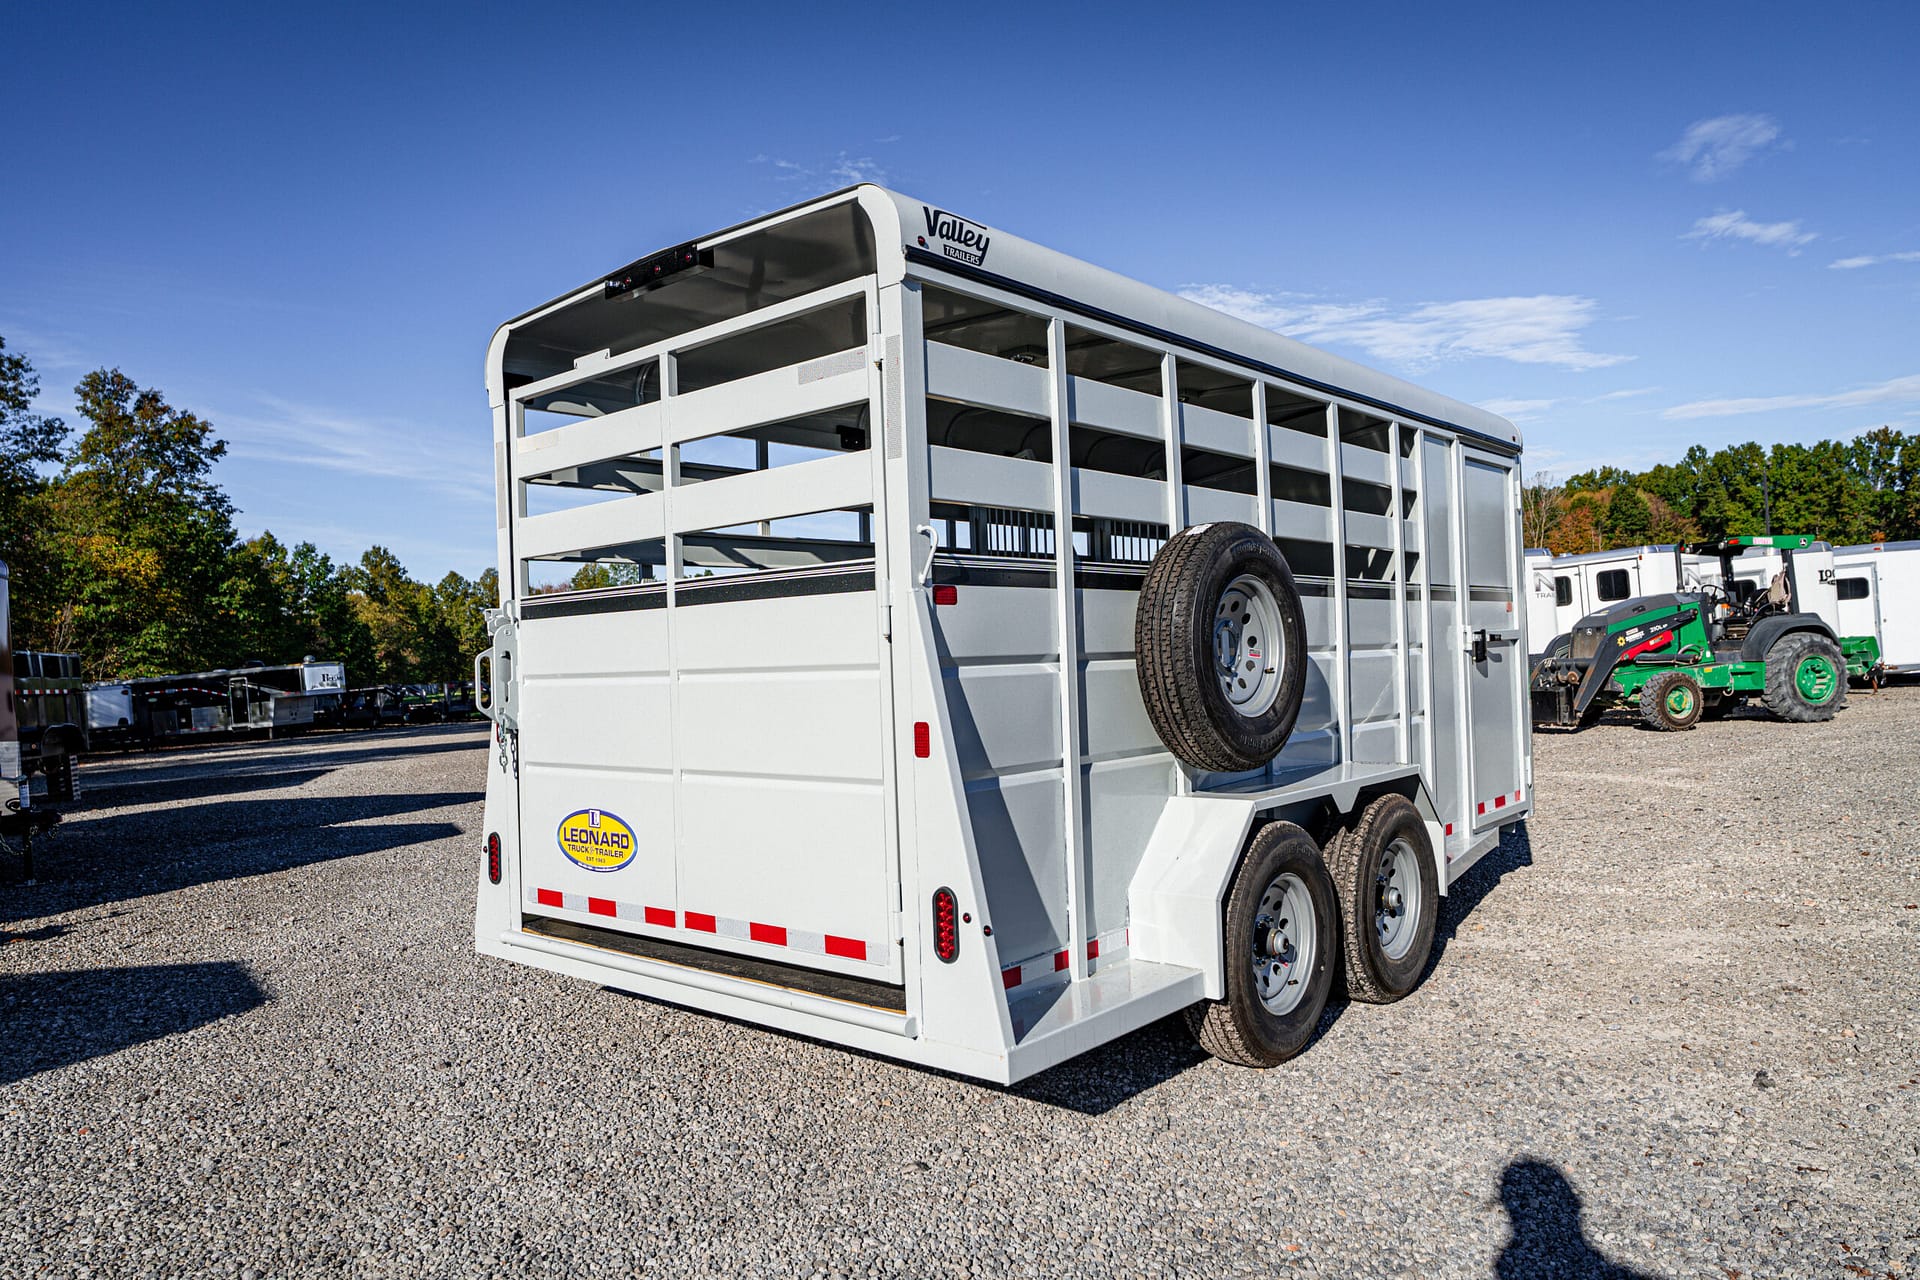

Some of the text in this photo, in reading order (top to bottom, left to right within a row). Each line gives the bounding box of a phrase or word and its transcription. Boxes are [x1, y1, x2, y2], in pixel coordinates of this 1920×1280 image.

[923, 206, 990, 266] Valley
[944, 246, 980, 265] TRAILERS
[563, 827, 629, 849] LEONARD
[568, 843, 590, 854] TRUCK
[595, 847, 624, 858] TRAILER
